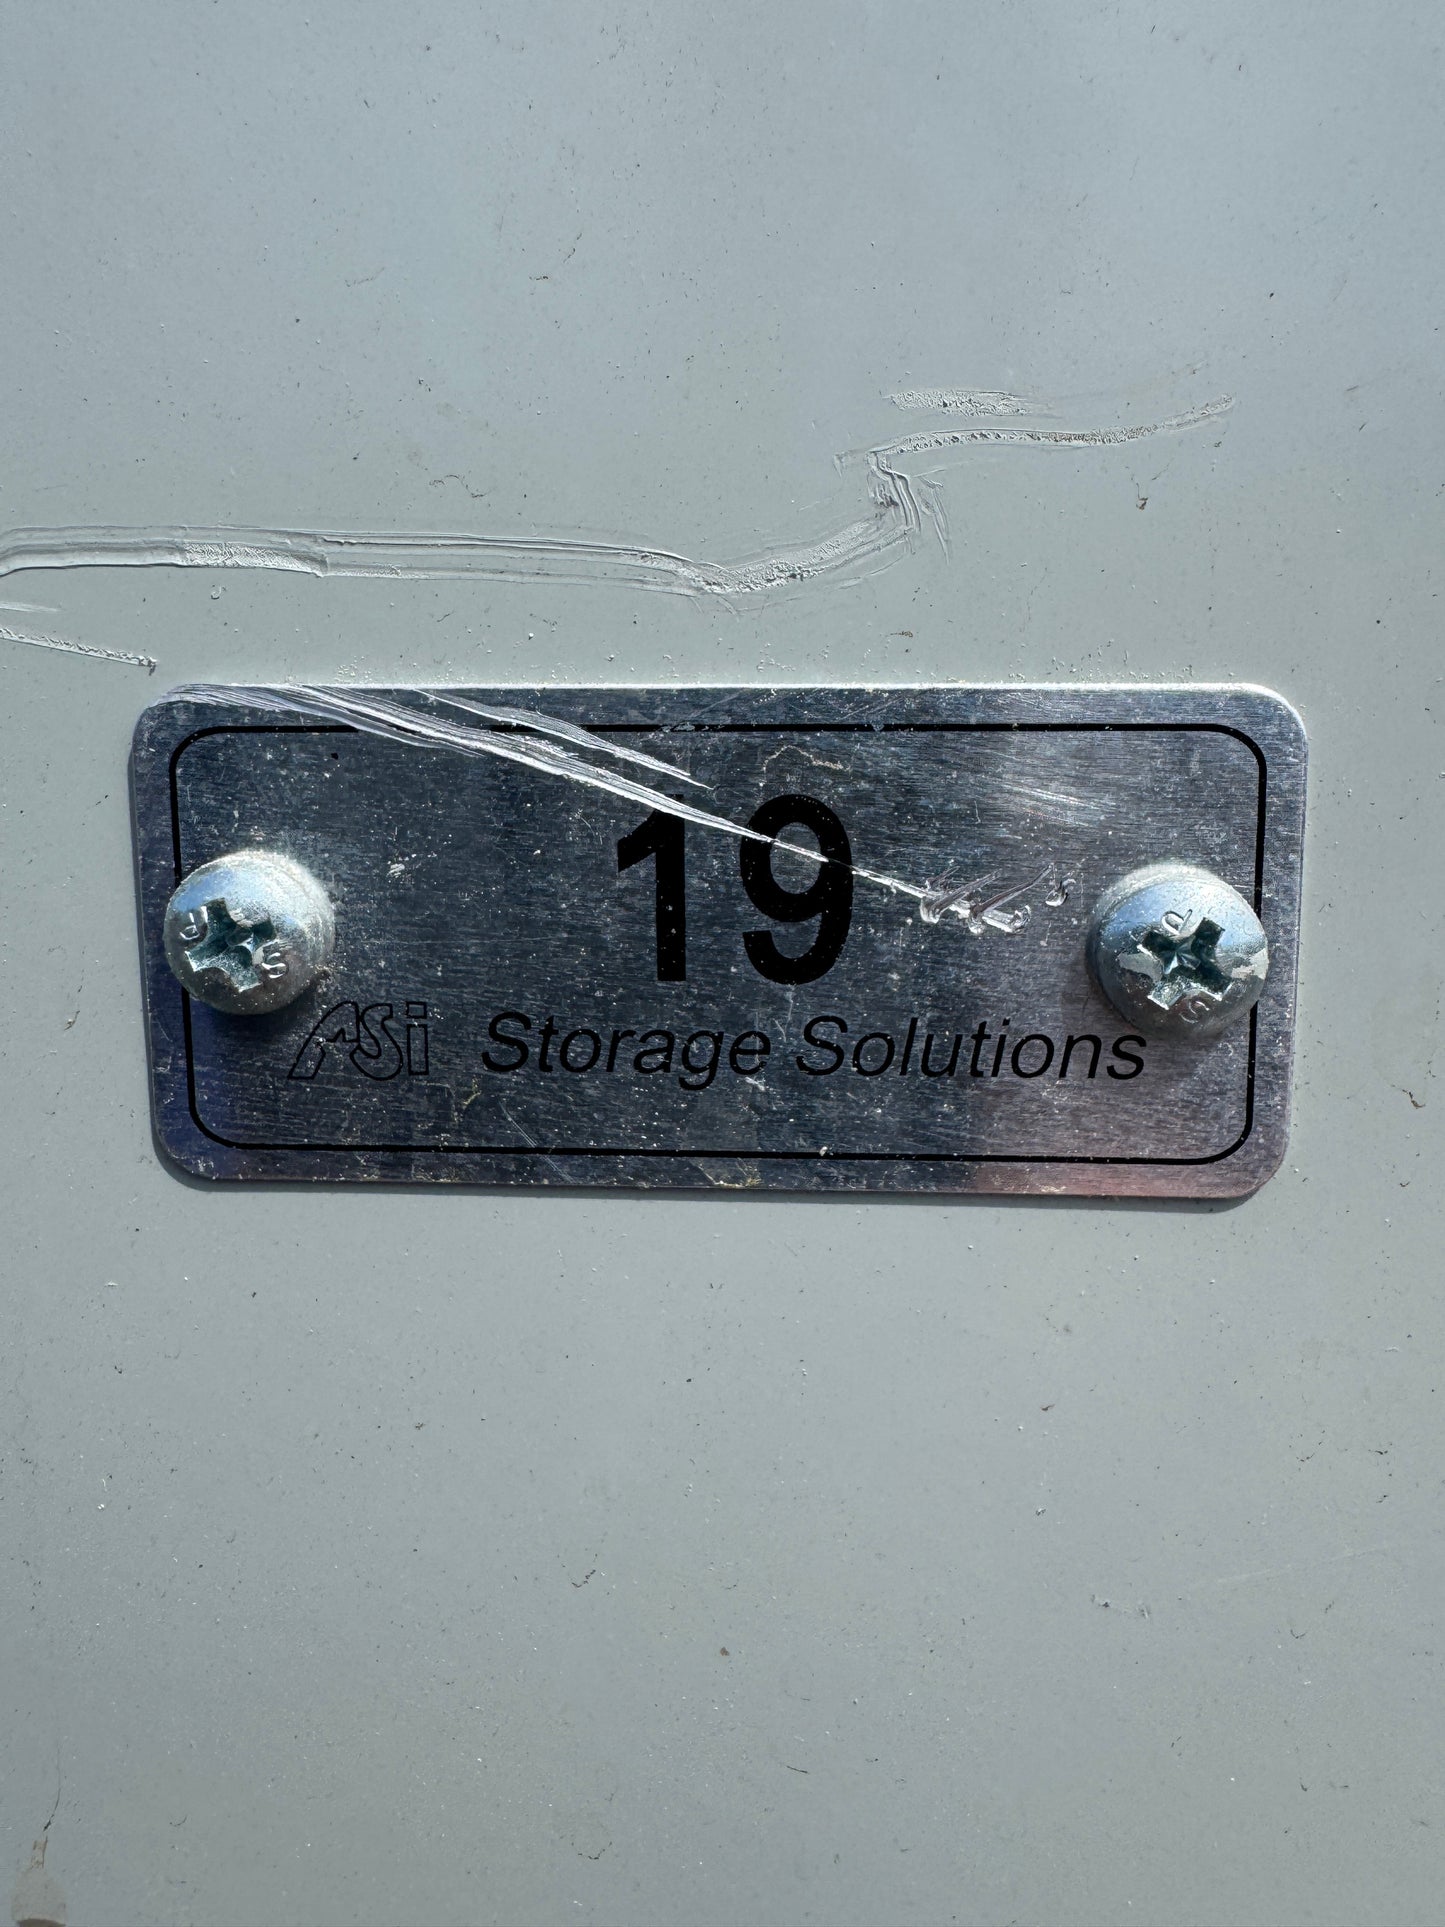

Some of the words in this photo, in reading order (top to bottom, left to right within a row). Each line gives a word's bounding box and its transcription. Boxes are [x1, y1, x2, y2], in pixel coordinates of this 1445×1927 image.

[617, 793, 854, 985] 19
[481, 1011, 772, 1092] Storage
[796, 1015, 1148, 1081] Solutions
